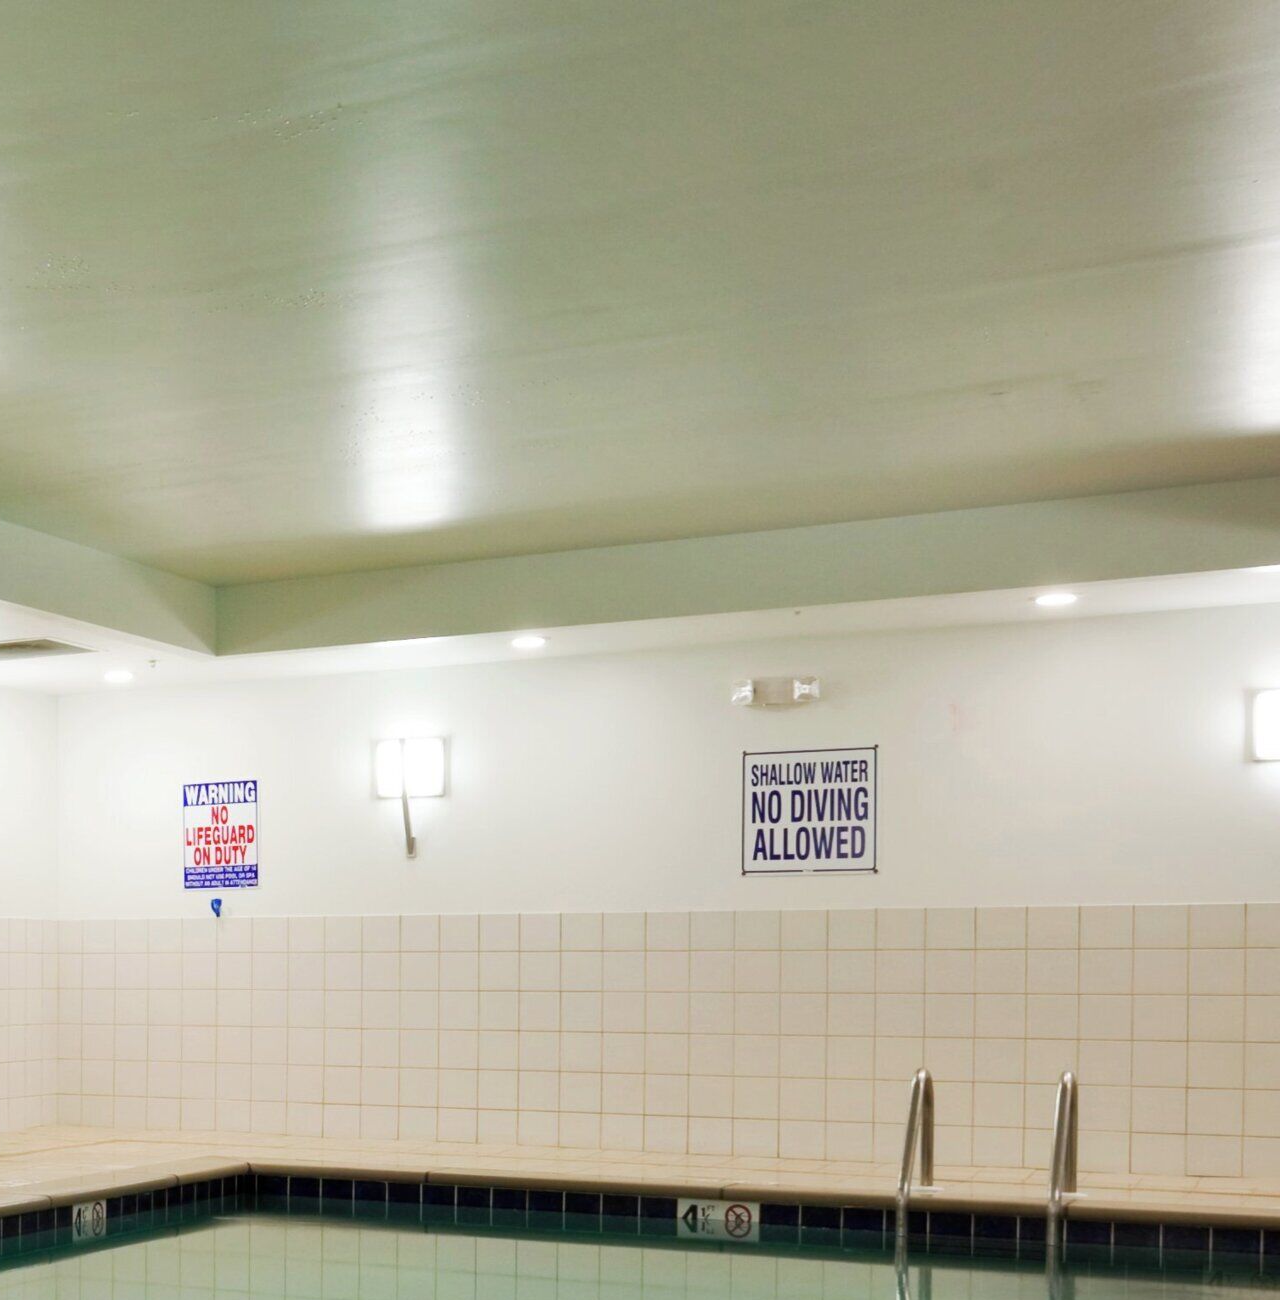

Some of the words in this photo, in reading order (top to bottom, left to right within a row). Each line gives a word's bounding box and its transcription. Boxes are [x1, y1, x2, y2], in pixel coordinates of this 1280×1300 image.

[751, 762, 816, 787] SHALLOW
[820, 760, 868, 783] WATER
[185, 781, 256, 807] WARNING
[752, 789, 781, 824] NO
[791, 787, 868, 822] DIVING
[211, 805, 228, 825] NO
[186, 824, 254, 846] LIFEGUARD
[753, 826, 865, 860] ALLOWED
[194, 846, 210, 866] ON
[215, 845, 246, 865] DUTY
